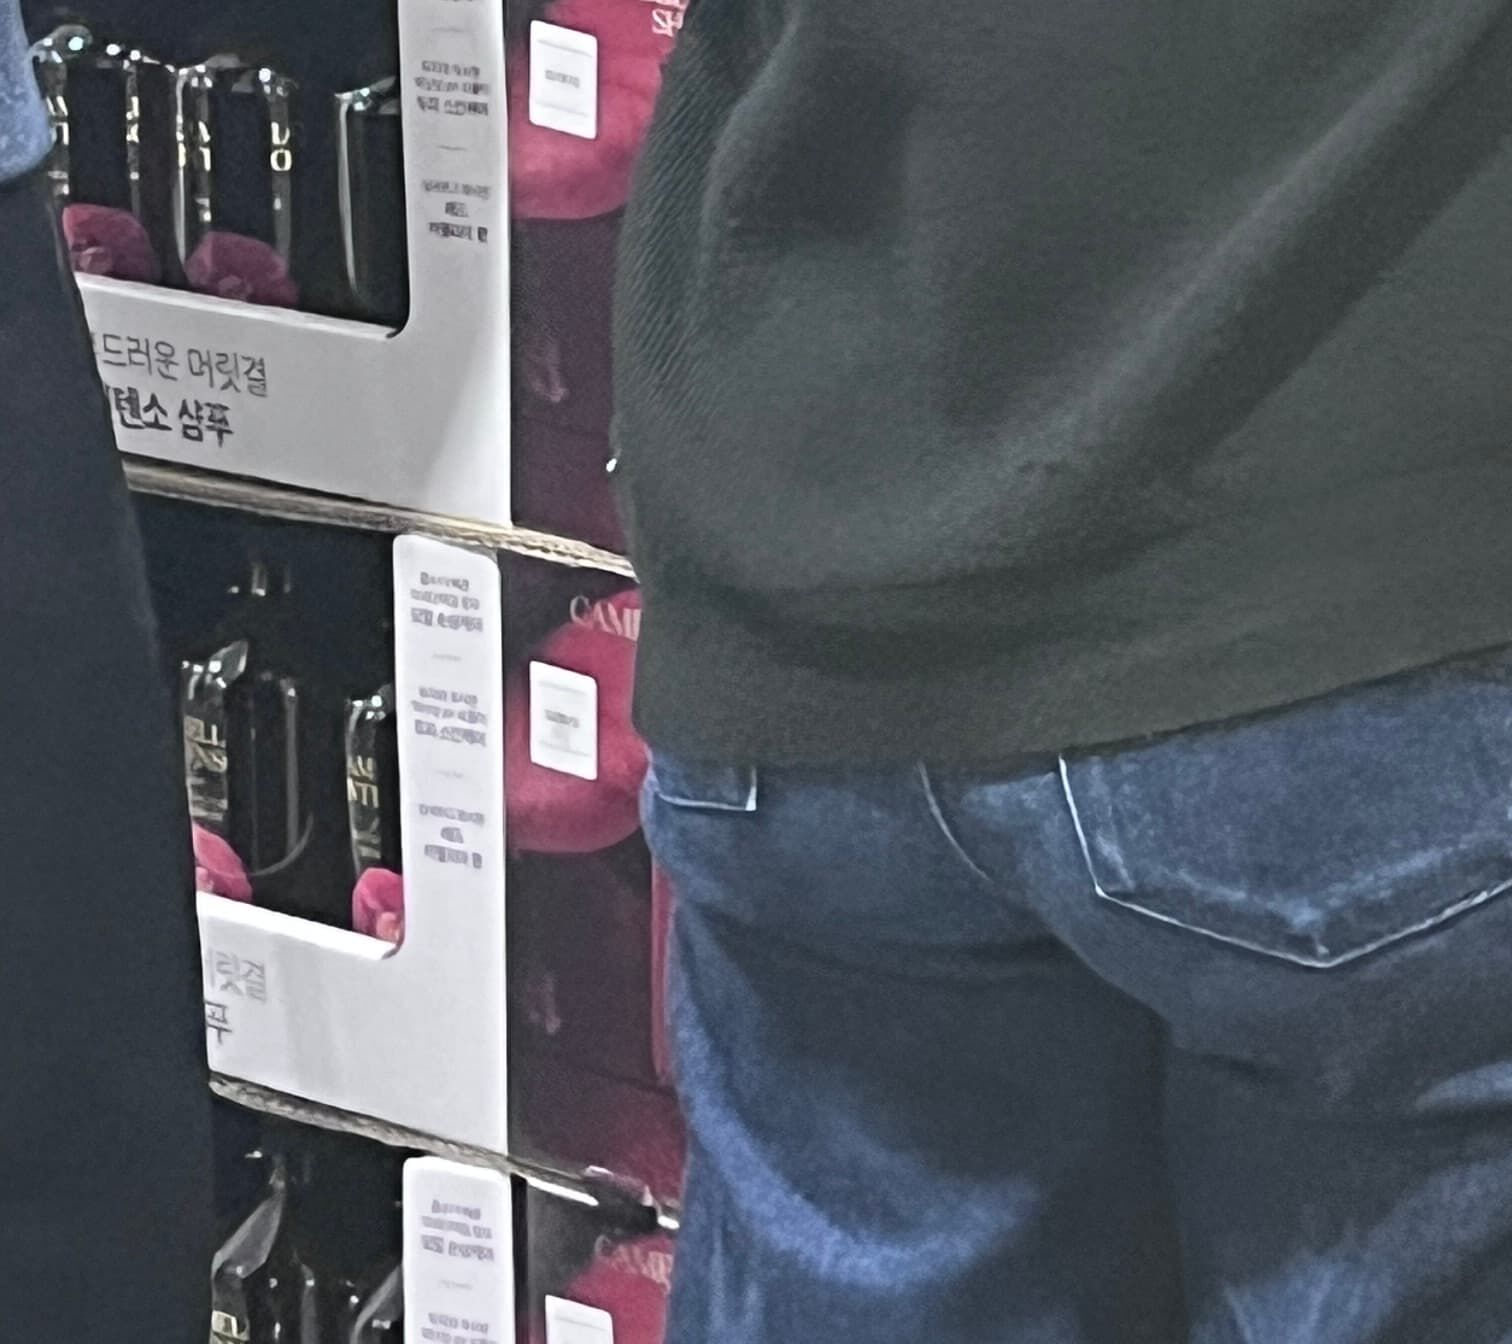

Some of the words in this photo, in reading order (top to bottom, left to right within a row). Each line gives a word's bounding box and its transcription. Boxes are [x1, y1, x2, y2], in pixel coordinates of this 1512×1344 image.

[92, 332, 179, 382] 드러운
[105, 384, 173, 431] 텐소
[177, 398, 235, 448] 샴푸
